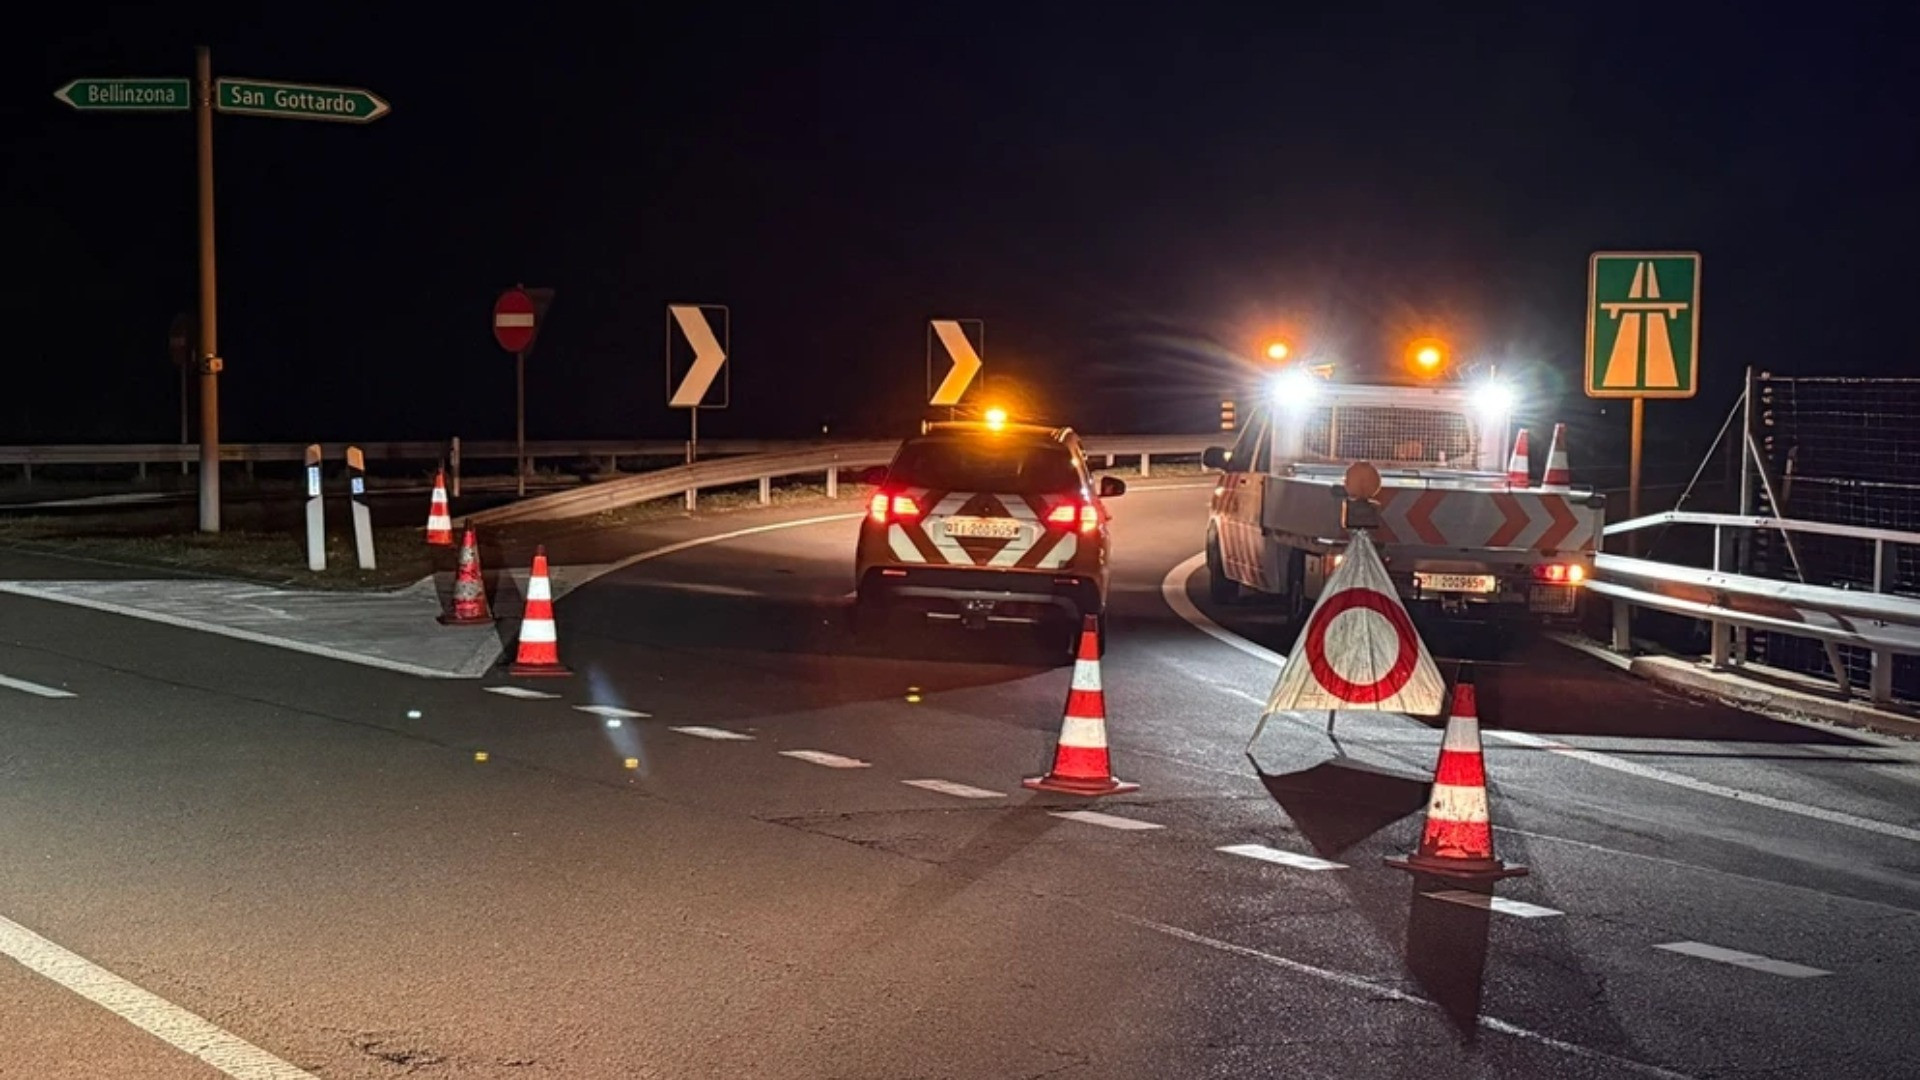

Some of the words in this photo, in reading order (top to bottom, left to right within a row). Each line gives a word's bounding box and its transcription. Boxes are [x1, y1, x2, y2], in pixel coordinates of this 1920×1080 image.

[88, 84, 176, 103] Bellinzona
[231, 86, 265, 106] San
[274, 89, 356, 113] Gottardo
